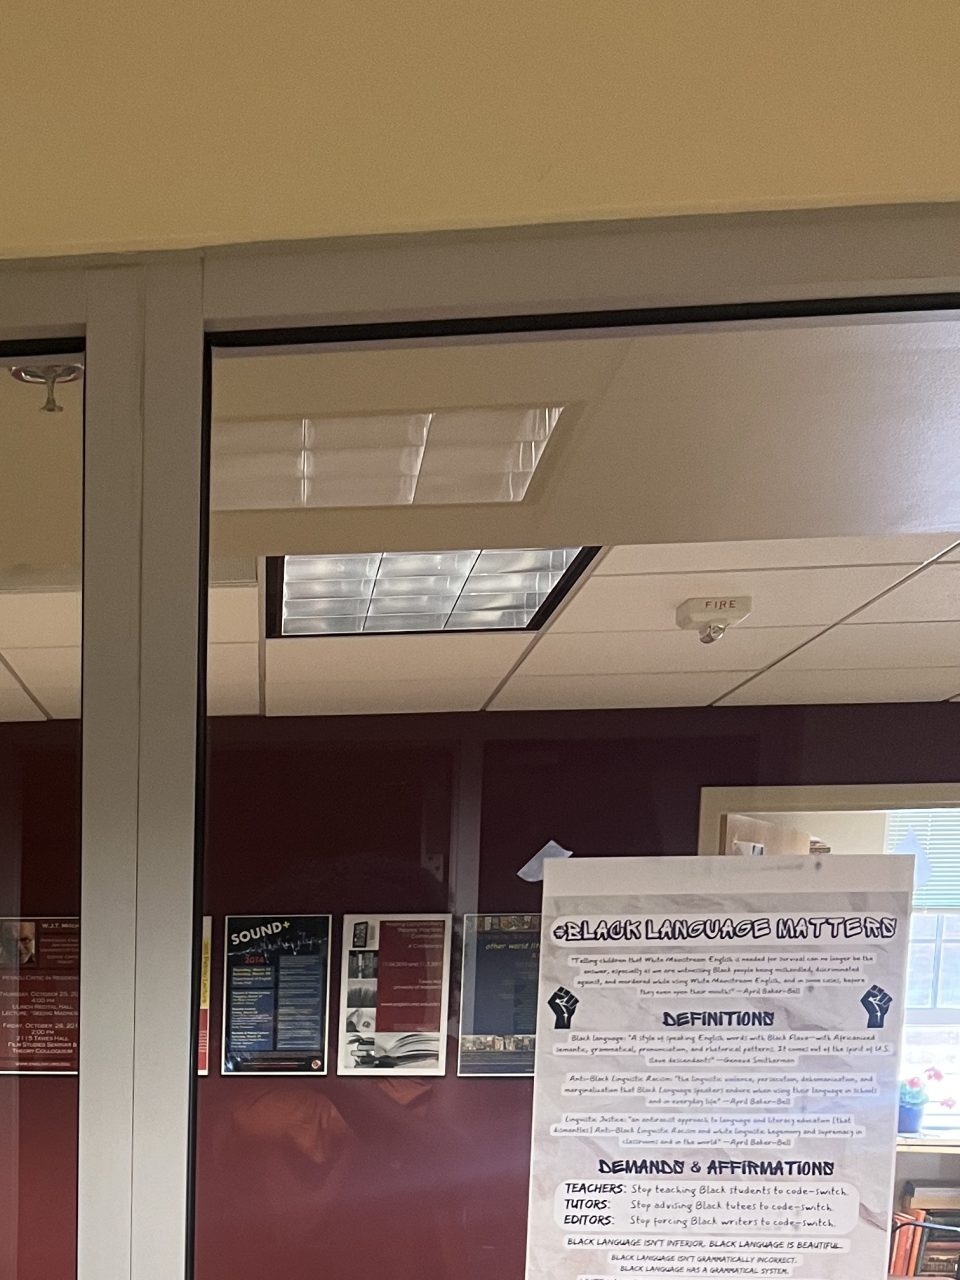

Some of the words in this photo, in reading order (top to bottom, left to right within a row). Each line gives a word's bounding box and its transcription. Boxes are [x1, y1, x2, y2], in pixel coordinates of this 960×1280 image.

[706, 600, 736, 609] FIRE
[231, 921, 290, 945] SOUND+
[554, 920, 642, 941] #BLACK
[645, 918, 771, 940] LANGUAGE
[777, 917, 897, 939] MATTERS
[663, 1011, 775, 1027] DEFINITIONS
[598, 1159, 684, 1174] DEMANDS
[691, 1161, 701, 1173] &
[707, 1159, 834, 1176] AFFIRMATIONS
[565, 1183, 626, 1194] TEACHERS:
[631, 1184, 651, 1196] Stop
[656, 1185, 696, 1197] teaching
[700, 1185, 726, 1194] Black
[730, 1186, 770, 1195] students
[774, 1186, 783, 1194] to
[786, 1186, 848, 1196] code-switch.
[565, 1199, 610, 1209] TUTORS:
[630, 1200, 651, 1212] Stop
[654, 1202, 692, 1213] advising
[695, 1201, 721, 1209] Black
[726, 1202, 756, 1210] tutees
[760, 1202, 768, 1210] to
[772, 1202, 833, 1212] code-switch.
[564, 1215, 614, 1225] EDITORS:
[630, 1216, 650, 1227] Stop
[654, 1217, 687, 1228] forcing
[691, 1217, 717, 1225] Black
[721, 1217, 758, 1226] writers
[761, 1218, 770, 1226] to
[773, 1218, 836, 1228] code-switch.
[568, 1238, 593, 1246] BLACK
[709, 1240, 736, 1248] BLACK
